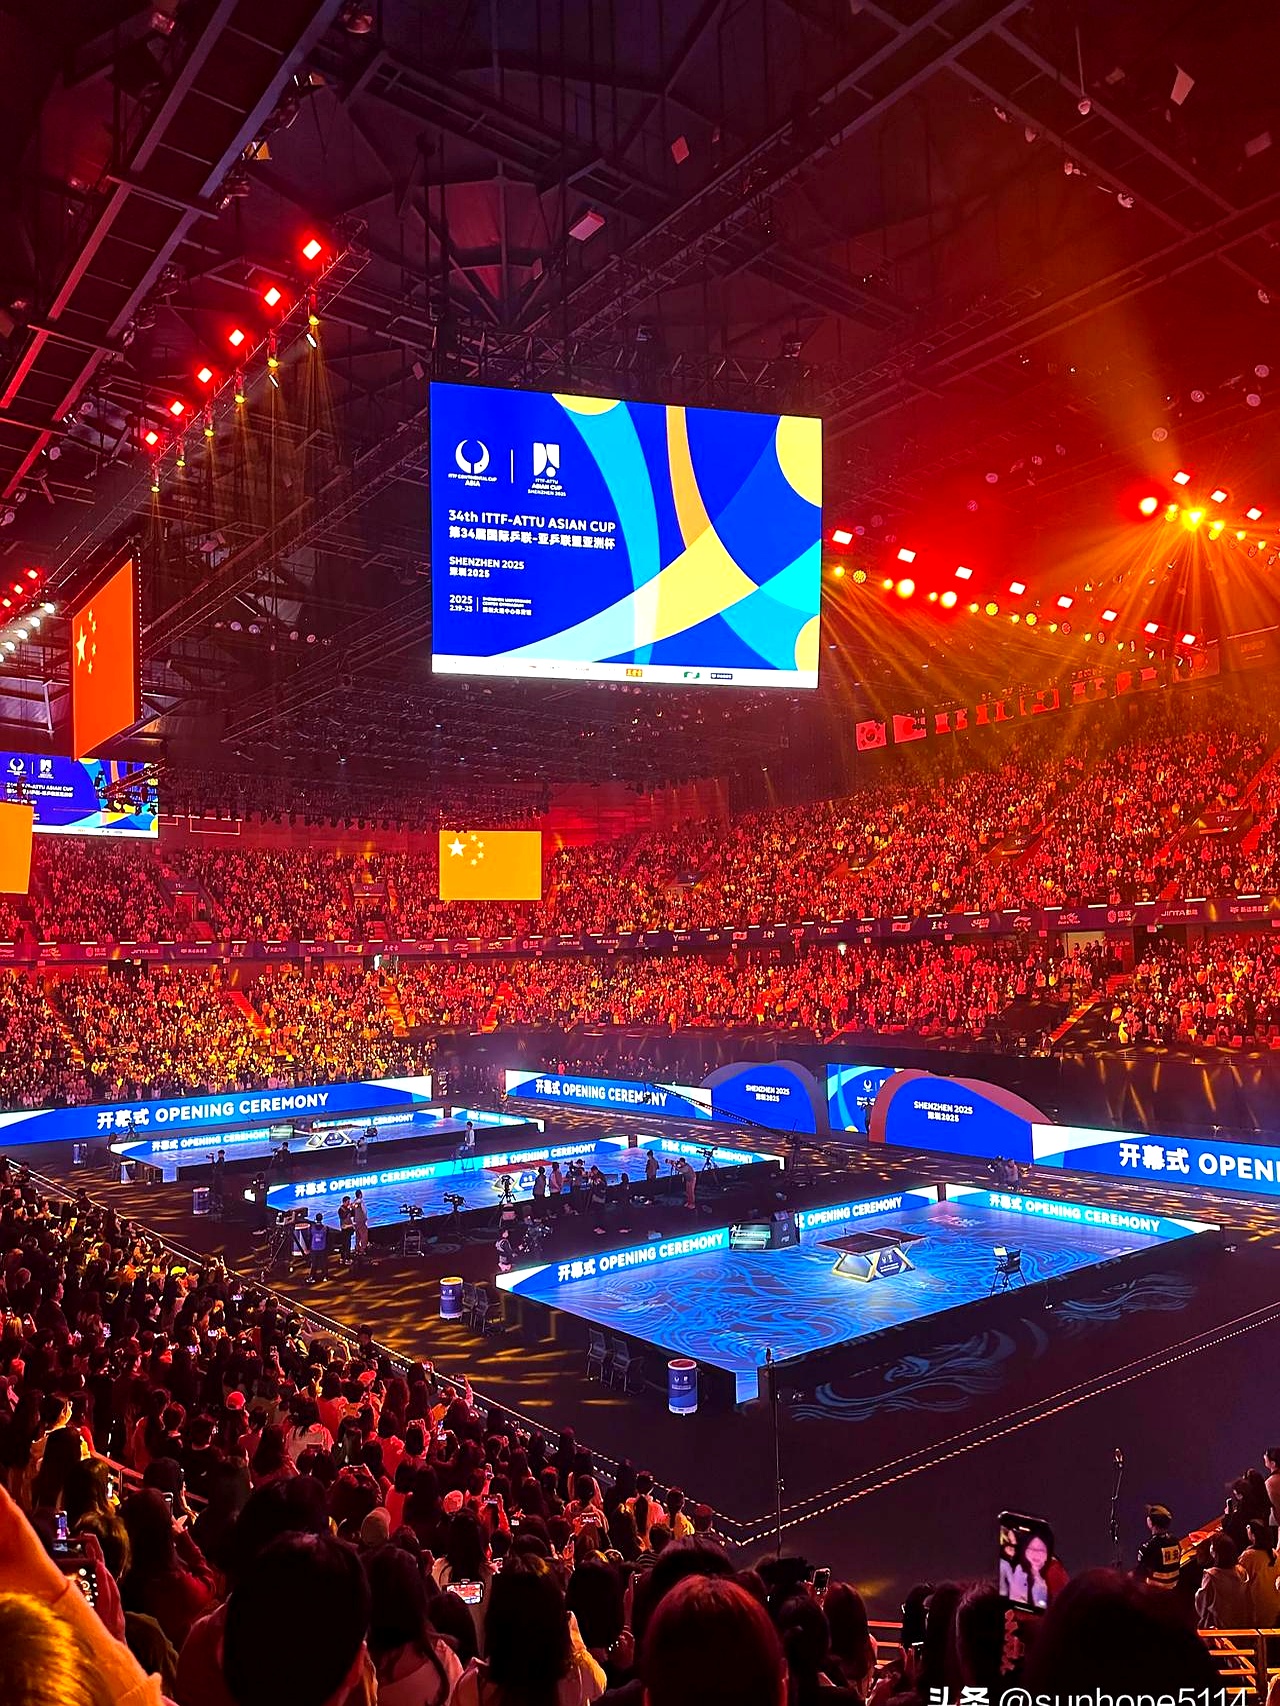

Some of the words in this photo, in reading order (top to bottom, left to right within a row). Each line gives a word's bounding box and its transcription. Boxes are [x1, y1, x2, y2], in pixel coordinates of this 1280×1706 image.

[449, 510, 478, 523] 34th
[481, 512, 545, 528] ITTF-ATTU
[548, 518, 587, 531] ASIAN
[590, 521, 616, 533] CUP
[449, 556, 500, 568] SHENZHEN
[502, 560, 524, 569] 2025
[449, 595, 473, 604] 2025
[563, 1083, 605, 1100] OPENING
[97, 1108, 149, 1130] 开幕式
[155, 1102, 235, 1123] OPENING
[239, 1092, 329, 1115] CEREMONY
[913, 1100, 953, 1112] SHENZHEN
[954, 1105, 973, 1114] 2025
[180, 1134, 221, 1148] OPENING
[551, 1143, 596, 1157] CEREMONY
[1119, 1142, 1190, 1174] 开幕式
[330, 1173, 378, 1191] OPENING
[380, 1166, 436, 1183] CEREMONY
[807, 1207, 850, 1226] OPENING
[852, 1196, 902, 1217] CEREMONY
[989, 1195, 1022, 1210] 开幕式
[1025, 1202, 1081, 1219] OPENING
[1085, 1210, 1160, 1232] CEREMONY
[558, 1259, 596, 1282] 开幕式
[600, 1248, 656, 1271] OPENING
[659, 1233, 723, 1257] CEREMONY
